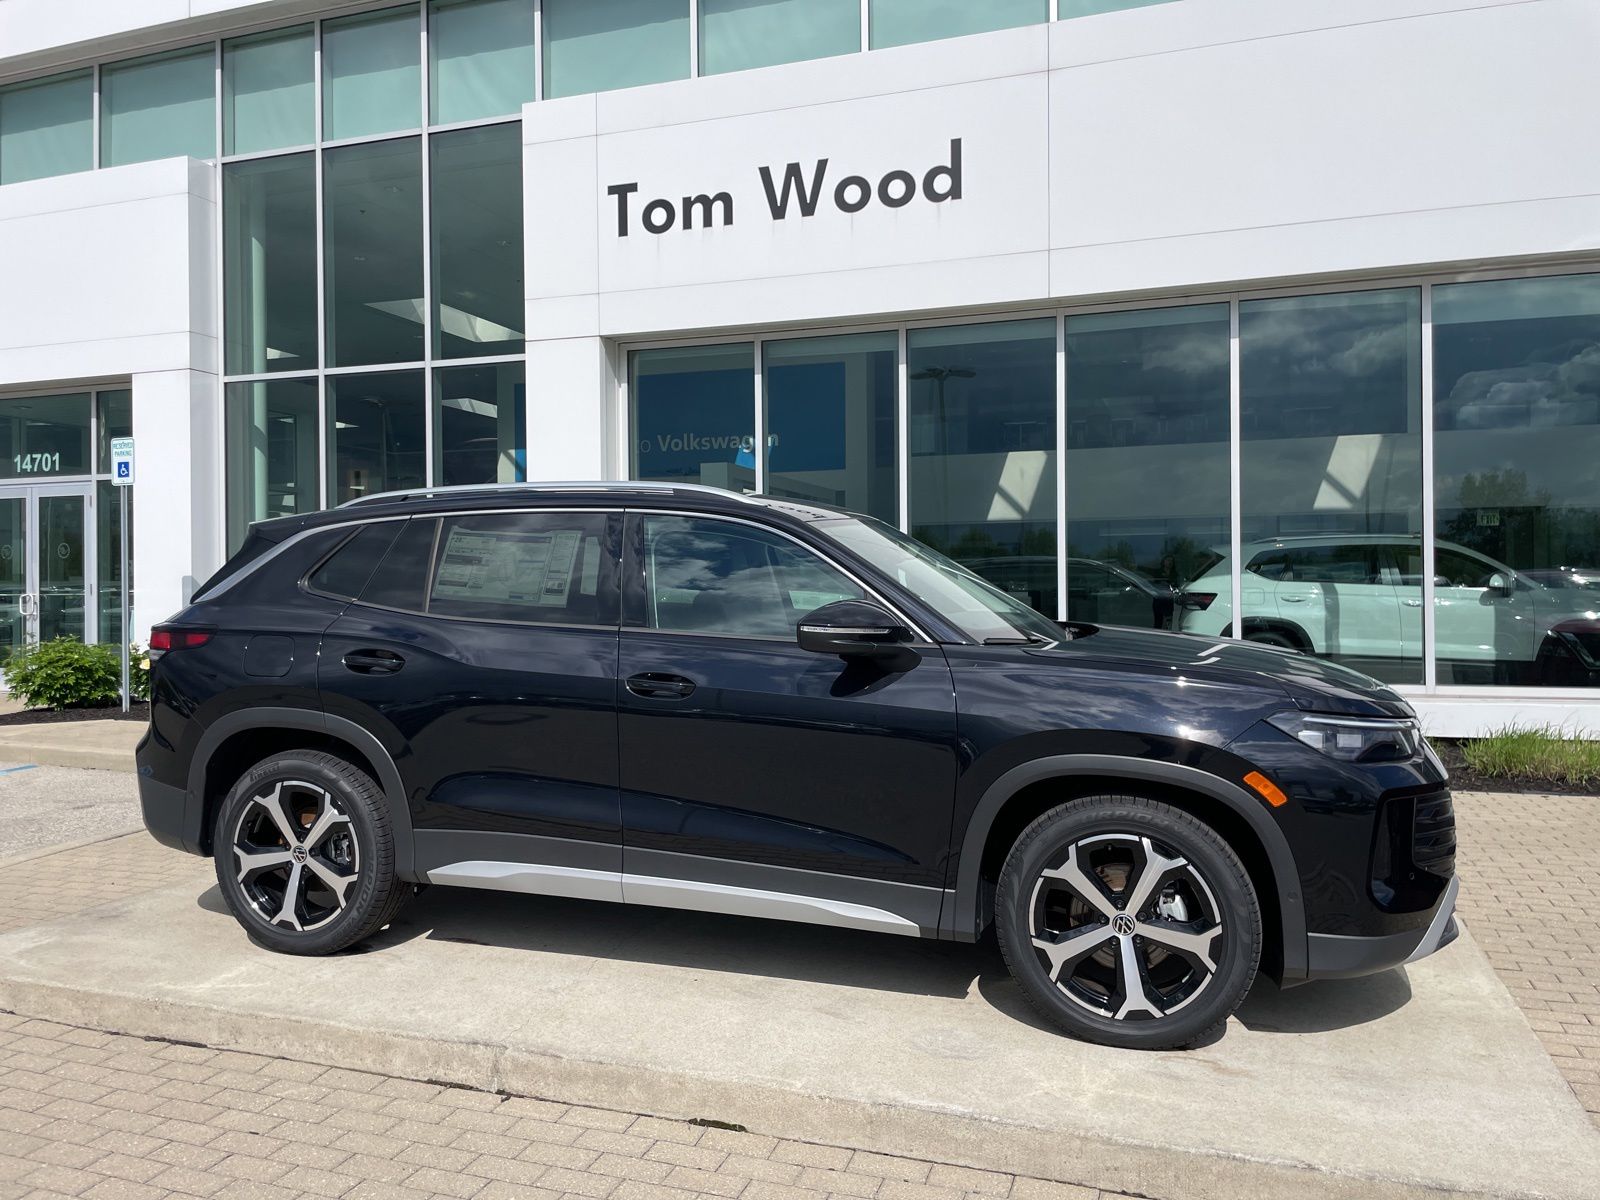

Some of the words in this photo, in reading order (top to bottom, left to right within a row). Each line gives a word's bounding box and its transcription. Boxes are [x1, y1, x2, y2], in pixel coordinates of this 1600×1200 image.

[607, 182, 734, 238] Tom
[758, 137, 962, 221] Wood
[114, 449, 133, 457] PARKING
[657, 432, 779, 454] Volkswagn
[13, 452, 60, 473] 14701
